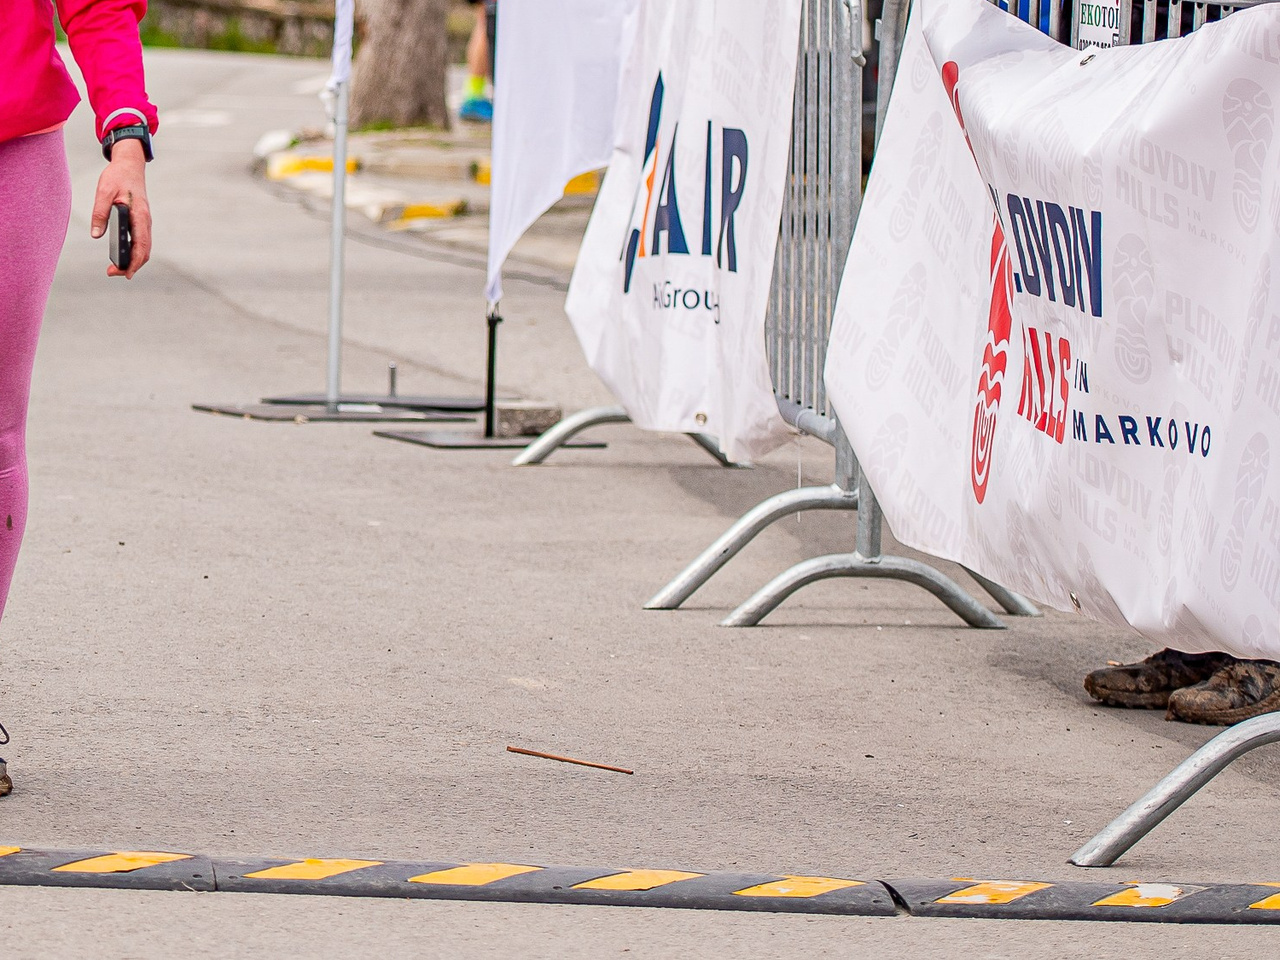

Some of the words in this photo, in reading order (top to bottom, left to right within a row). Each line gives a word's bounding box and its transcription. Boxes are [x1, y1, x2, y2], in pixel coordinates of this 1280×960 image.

[1116, 165, 1179, 229] HILLS
[1187, 207, 1201, 221] IN
[1188, 223, 1246, 266] MARKOVO
[1074, 358, 1089, 394] IN
[1072, 409, 1211, 458] MARKOVO
[1068, 476, 1118, 545] HILLS
